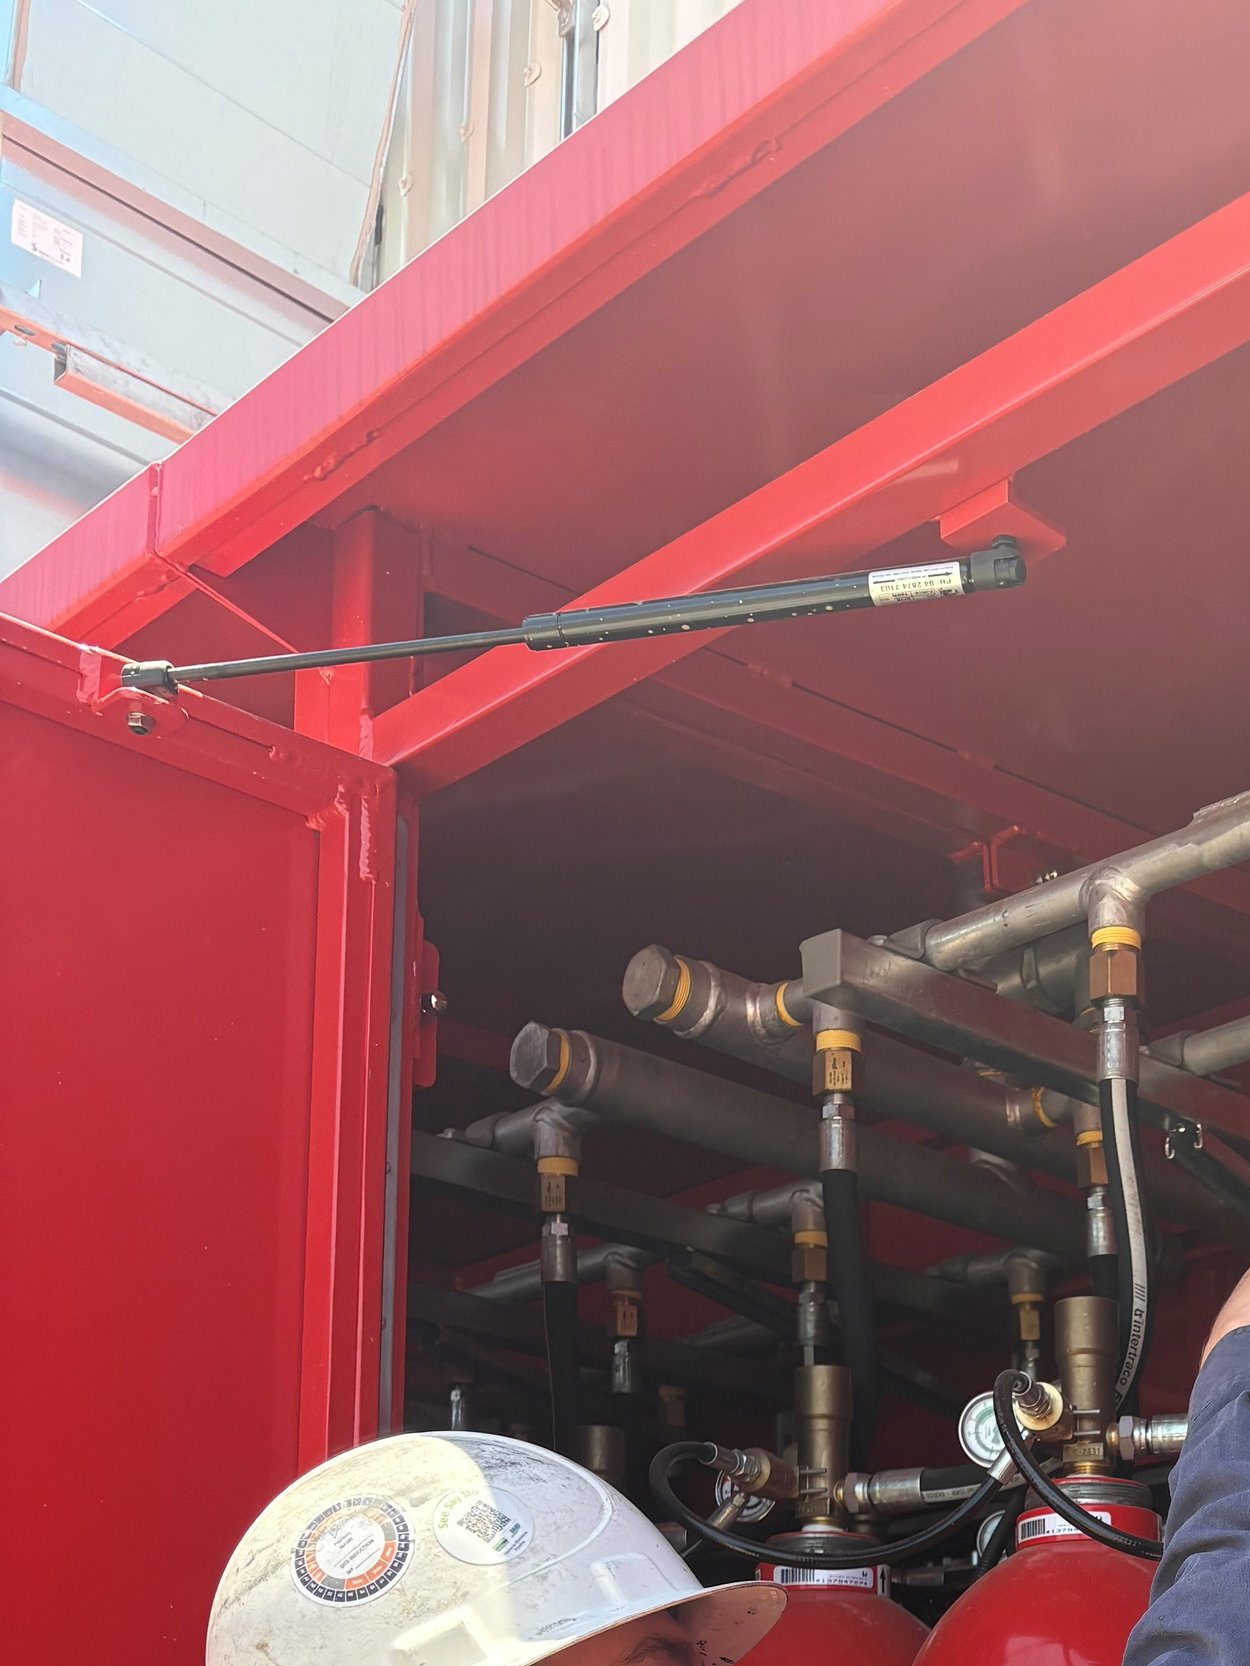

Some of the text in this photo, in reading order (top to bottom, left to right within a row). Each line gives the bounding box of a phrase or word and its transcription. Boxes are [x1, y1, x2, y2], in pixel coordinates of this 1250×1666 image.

[1119, 1319, 1144, 1386] intertraco
[443, 1496, 462, 1510] Say
[437, 1511, 450, 1530] See
